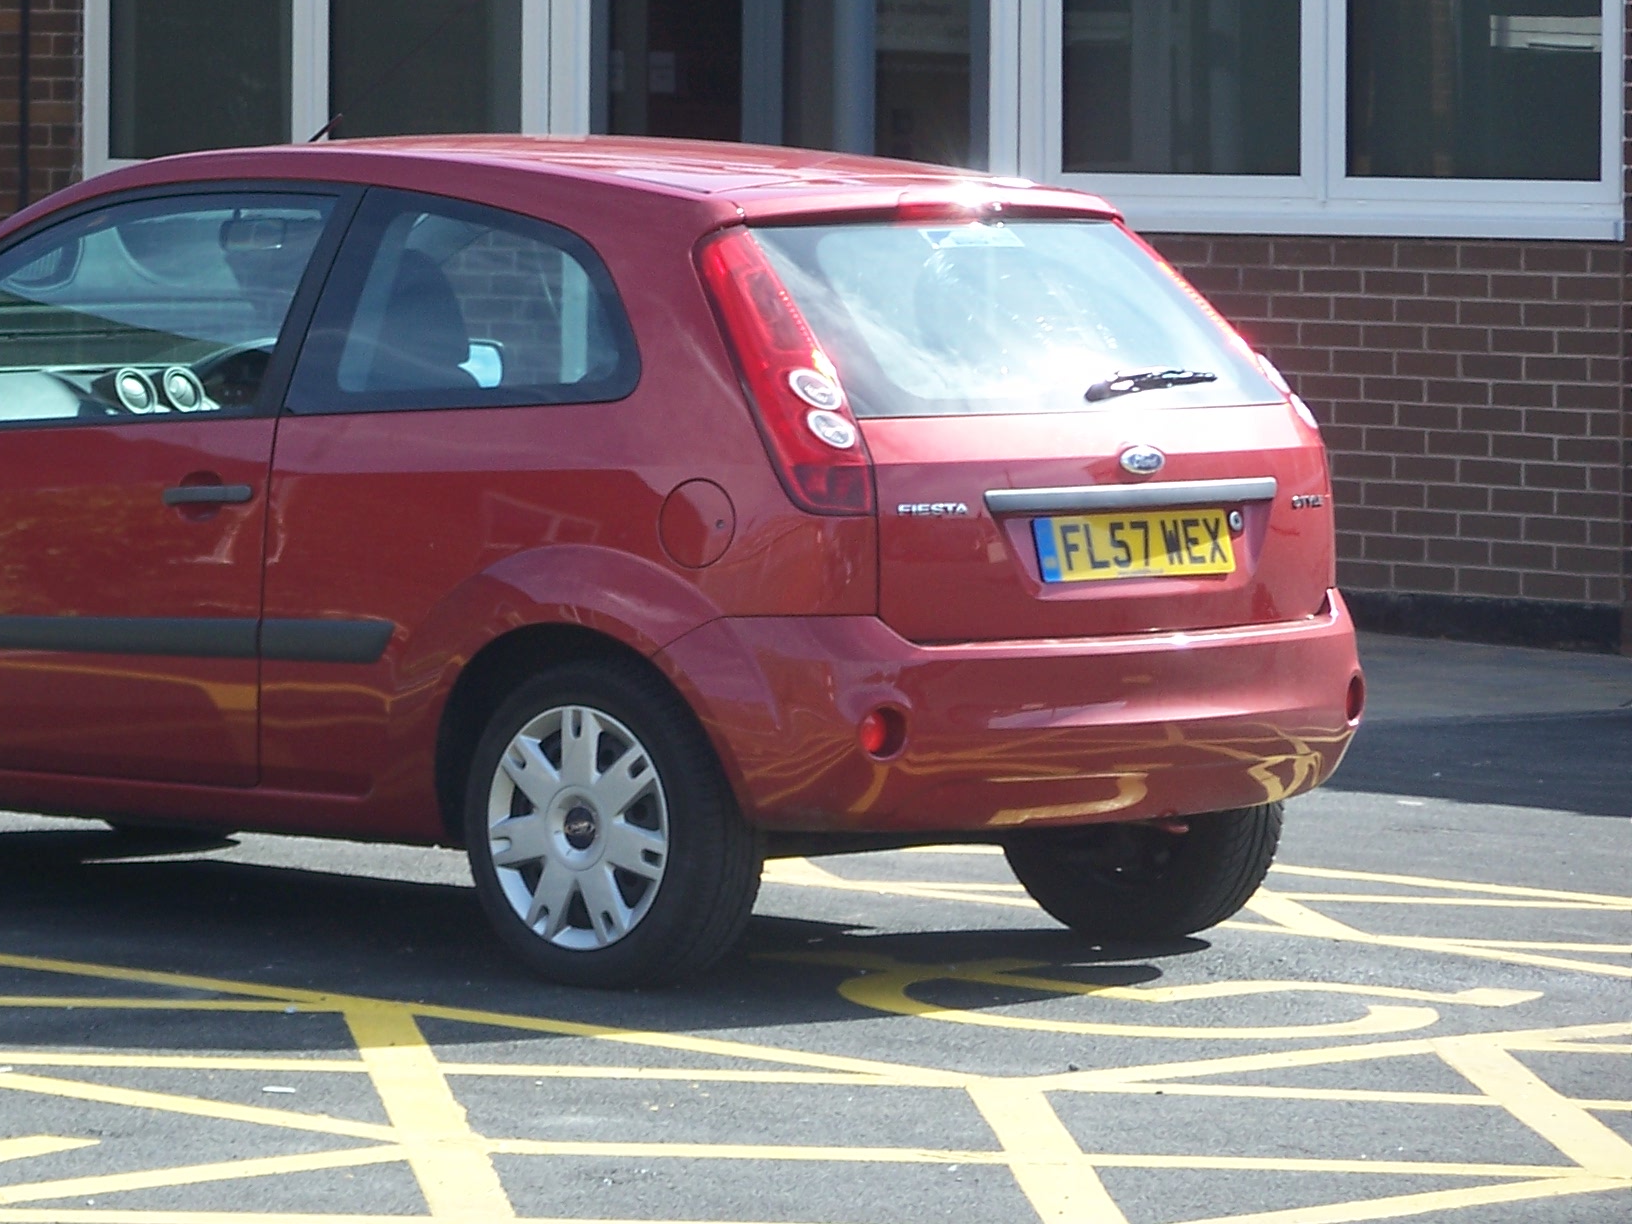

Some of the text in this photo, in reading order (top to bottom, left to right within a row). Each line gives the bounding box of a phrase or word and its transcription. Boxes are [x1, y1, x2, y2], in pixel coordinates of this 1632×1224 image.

[897, 502, 968, 516] FIESTA
[1060, 517, 1228, 571] FL57 WEX
